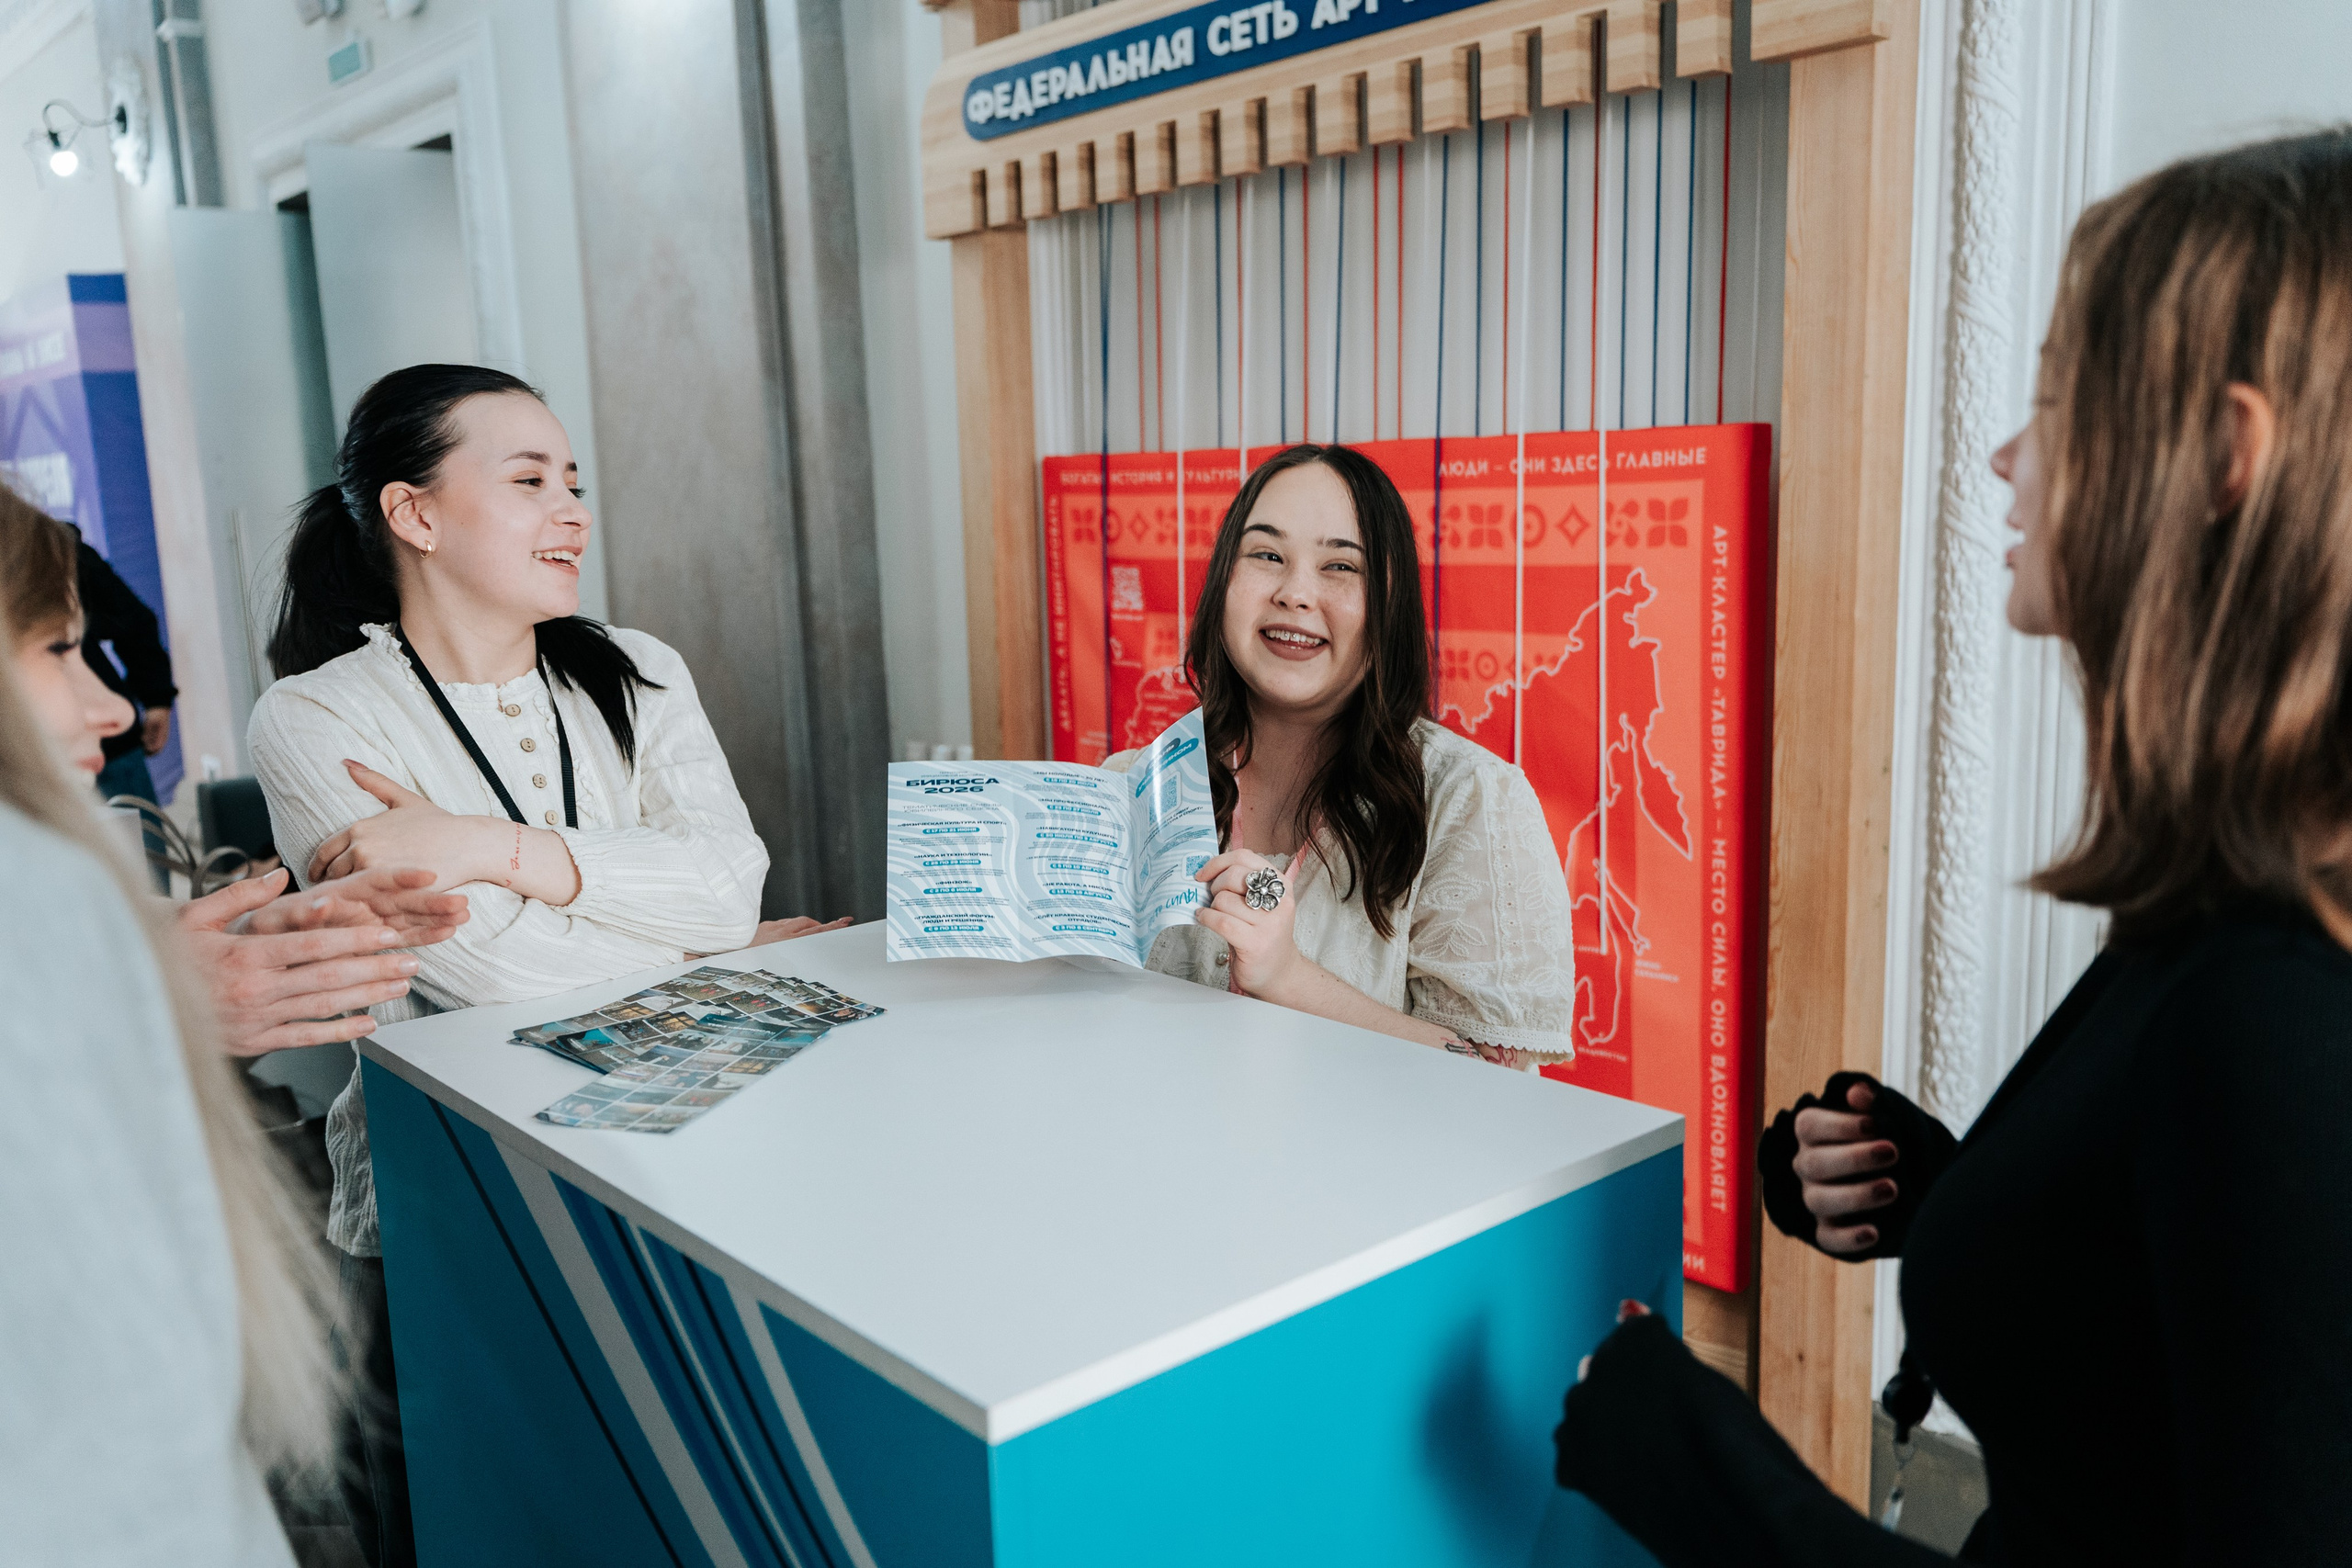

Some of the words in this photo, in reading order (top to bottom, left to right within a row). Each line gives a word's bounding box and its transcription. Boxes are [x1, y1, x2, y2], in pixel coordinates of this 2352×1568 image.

[967, 25, 1194, 124] ФЕДЕРАЛЬНАЯ
[1206, 0, 1300, 56] СЕТЬ
[1615, 447, 1707, 469] ГЛАВНЫЕ
[1711, 525, 1728, 681] АРТ-КЛАСТЕР
[906, 777, 1001, 787] БИРЮСА
[1710, 686, 1727, 810] «ТАВРИДА»
[924, 785, 984, 795] 2026
[1711, 838, 1727, 915] МЕСТО
[1711, 921, 1727, 992] СИЛЫ.
[1710, 998, 1726, 1048] ОНО
[1709, 1054, 1728, 1213] ВДОХНОВЛЯЕТ
